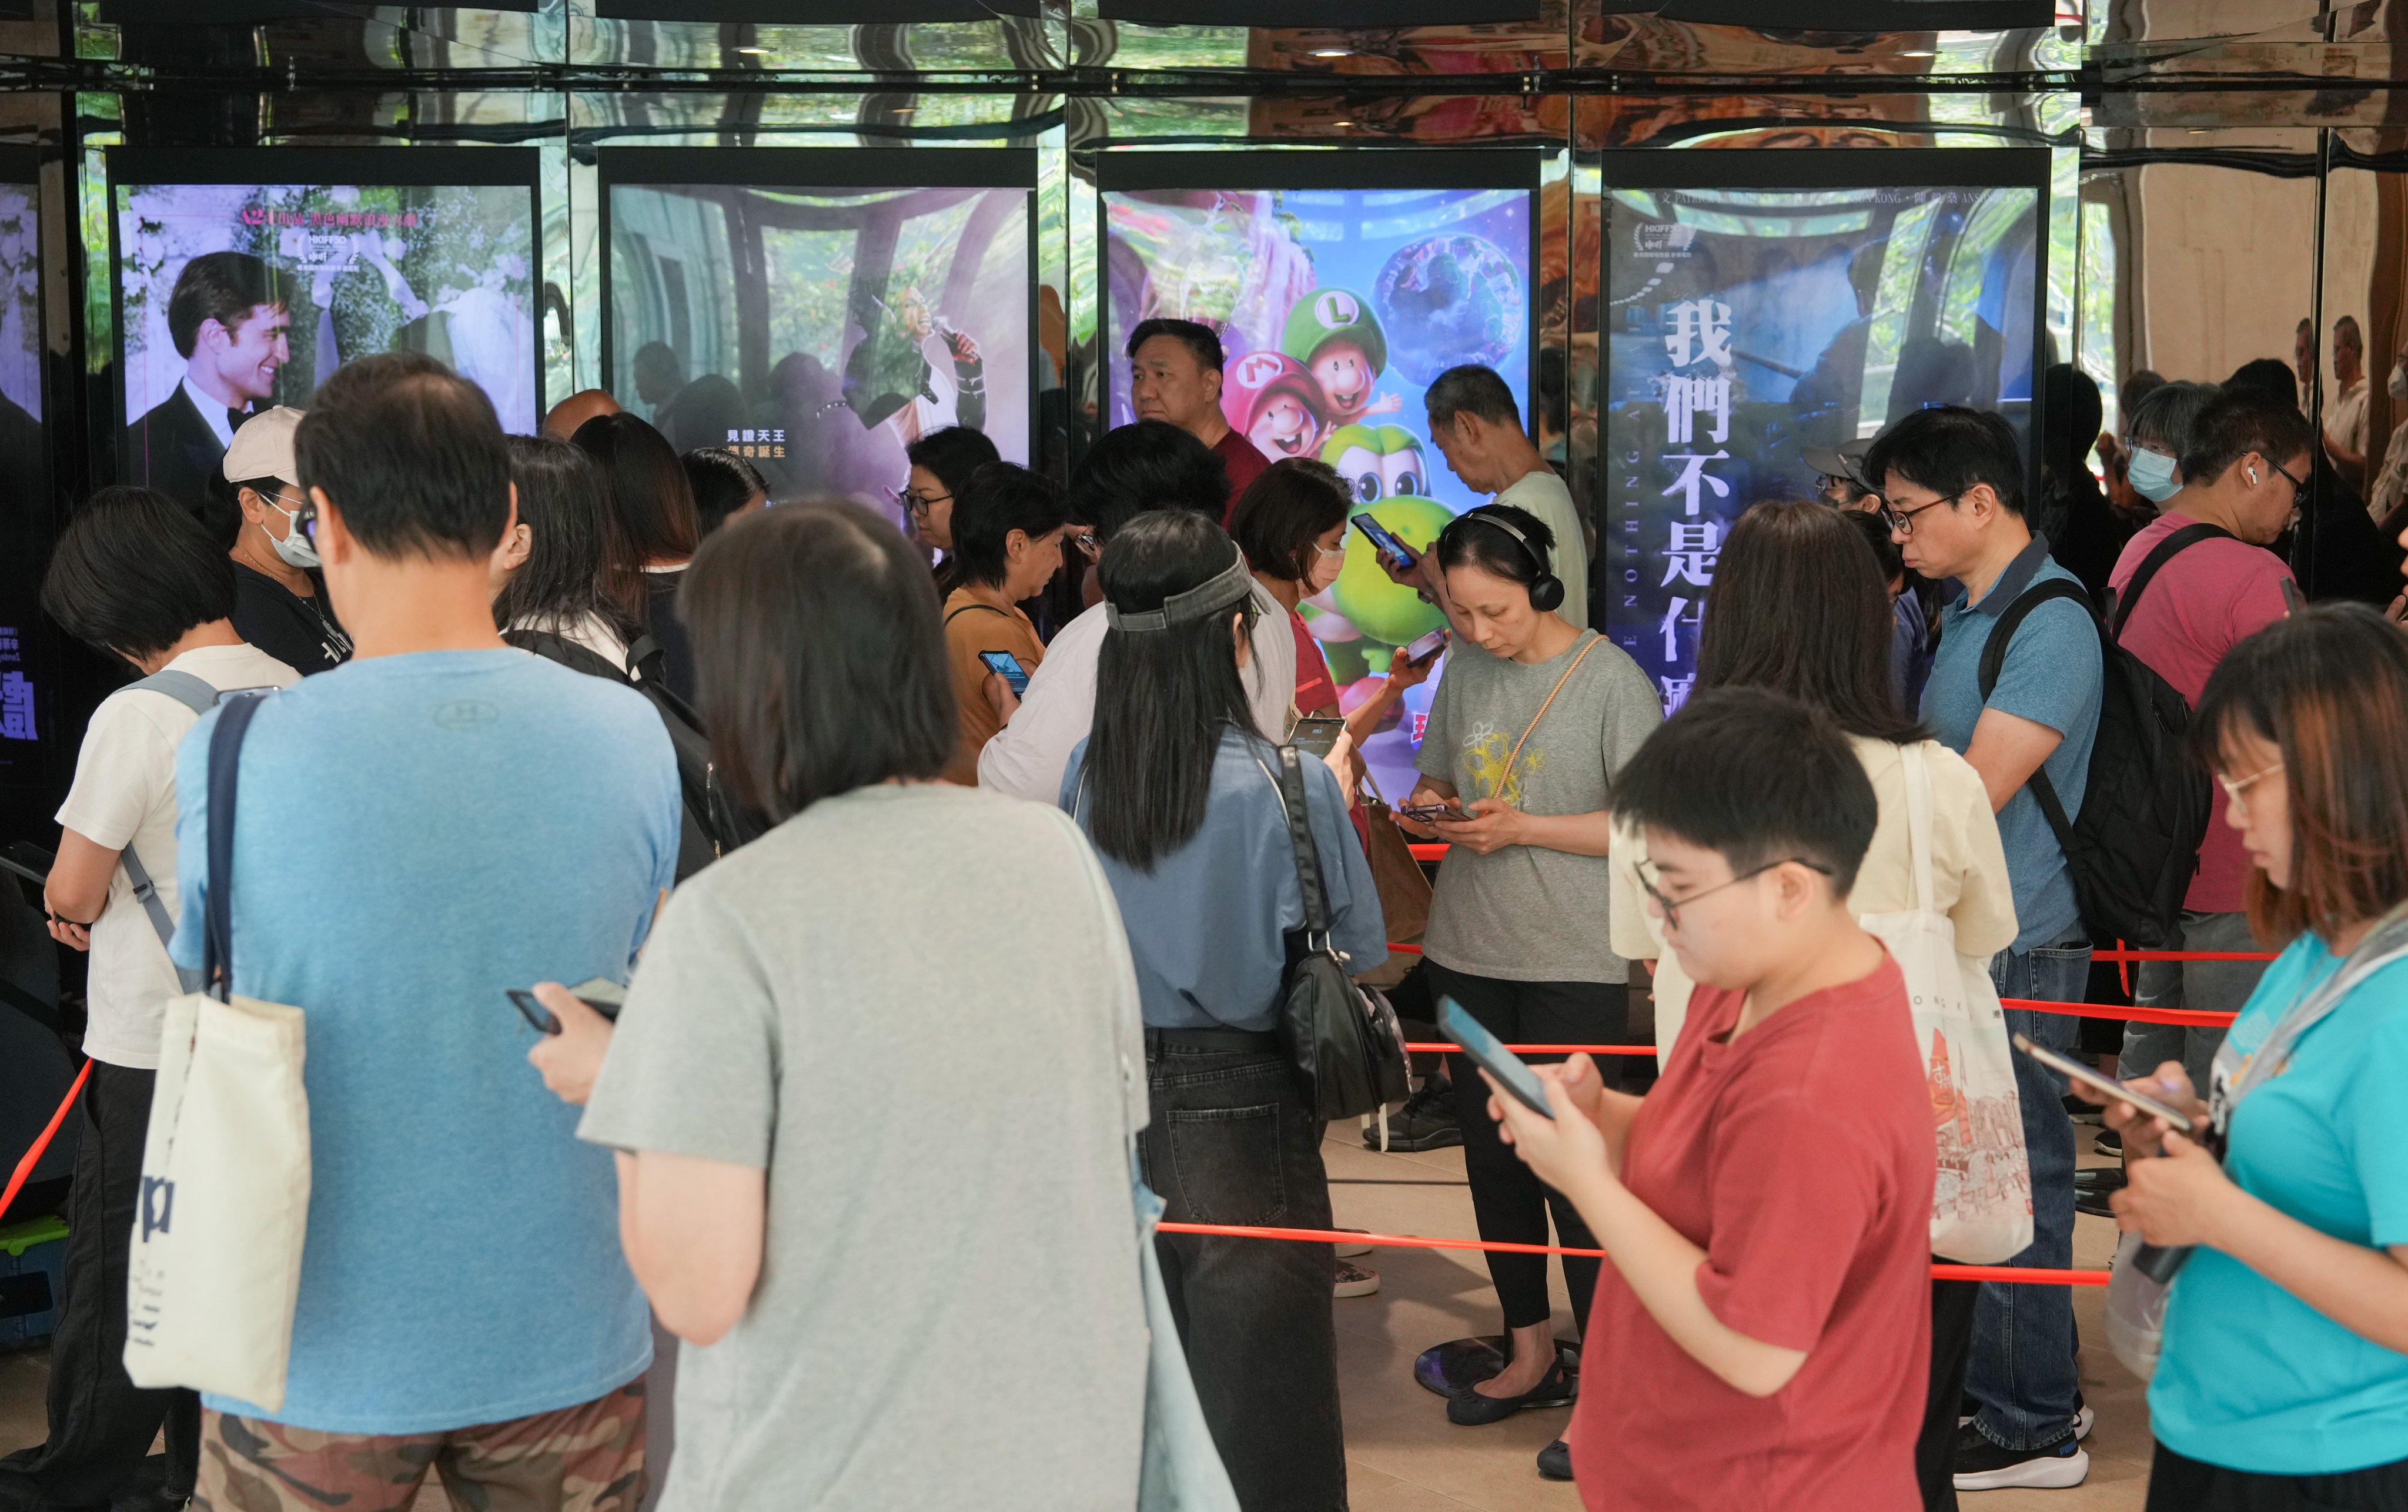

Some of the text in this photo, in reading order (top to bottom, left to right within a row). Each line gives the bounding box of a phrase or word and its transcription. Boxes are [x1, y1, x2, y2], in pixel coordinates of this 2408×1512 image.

[1875, 193, 1901, 203] KONG
[1327, 296, 1352, 323] L
[1245, 357, 1279, 383] M
[727, 429, 785, 442] 見證天王
[1624, 449, 1640, 608] NOTHING
